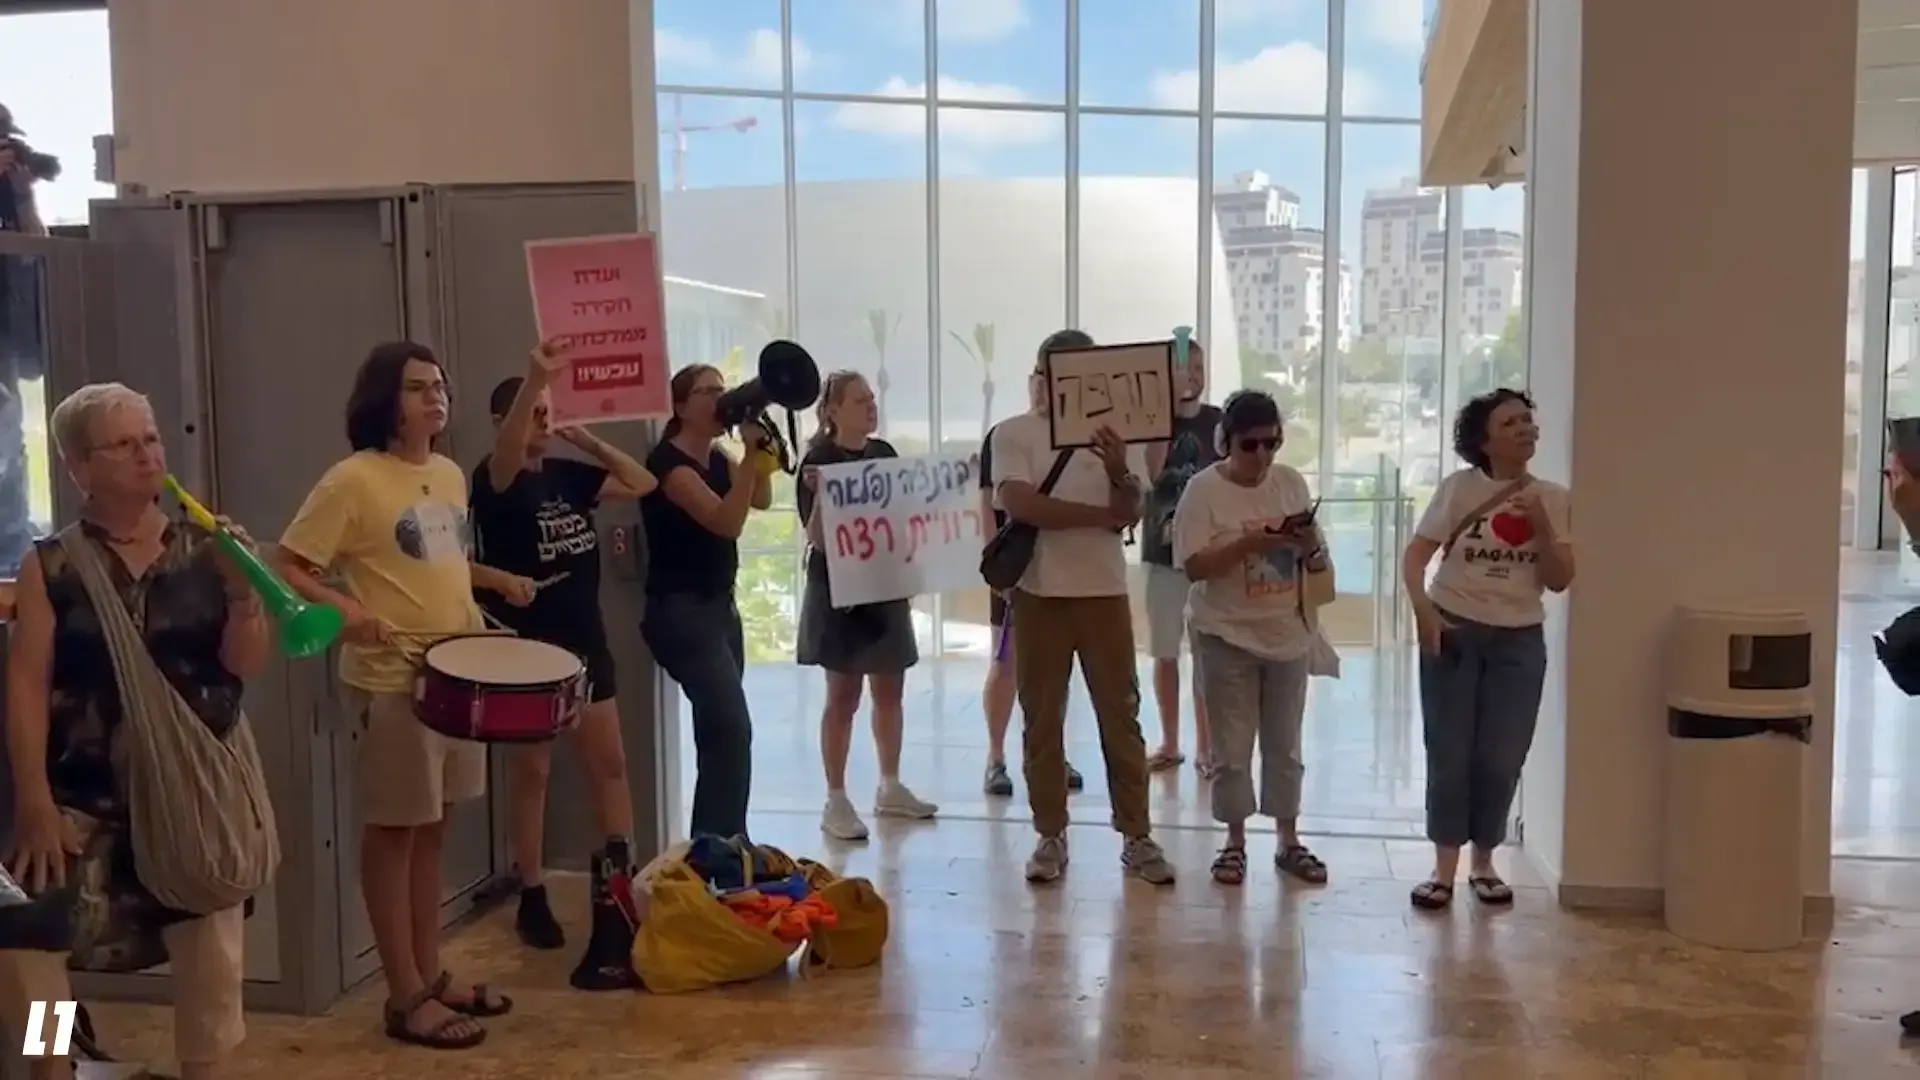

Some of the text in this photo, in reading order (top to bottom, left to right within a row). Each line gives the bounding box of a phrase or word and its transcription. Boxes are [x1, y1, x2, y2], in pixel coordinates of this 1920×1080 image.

[573, 267, 620, 284] ועדת
[572, 297, 632, 316] חקירה
[826, 463, 892, 509] נפלאה
[835, 515, 895, 561] רצח
[1466, 518, 1488, 539] I
